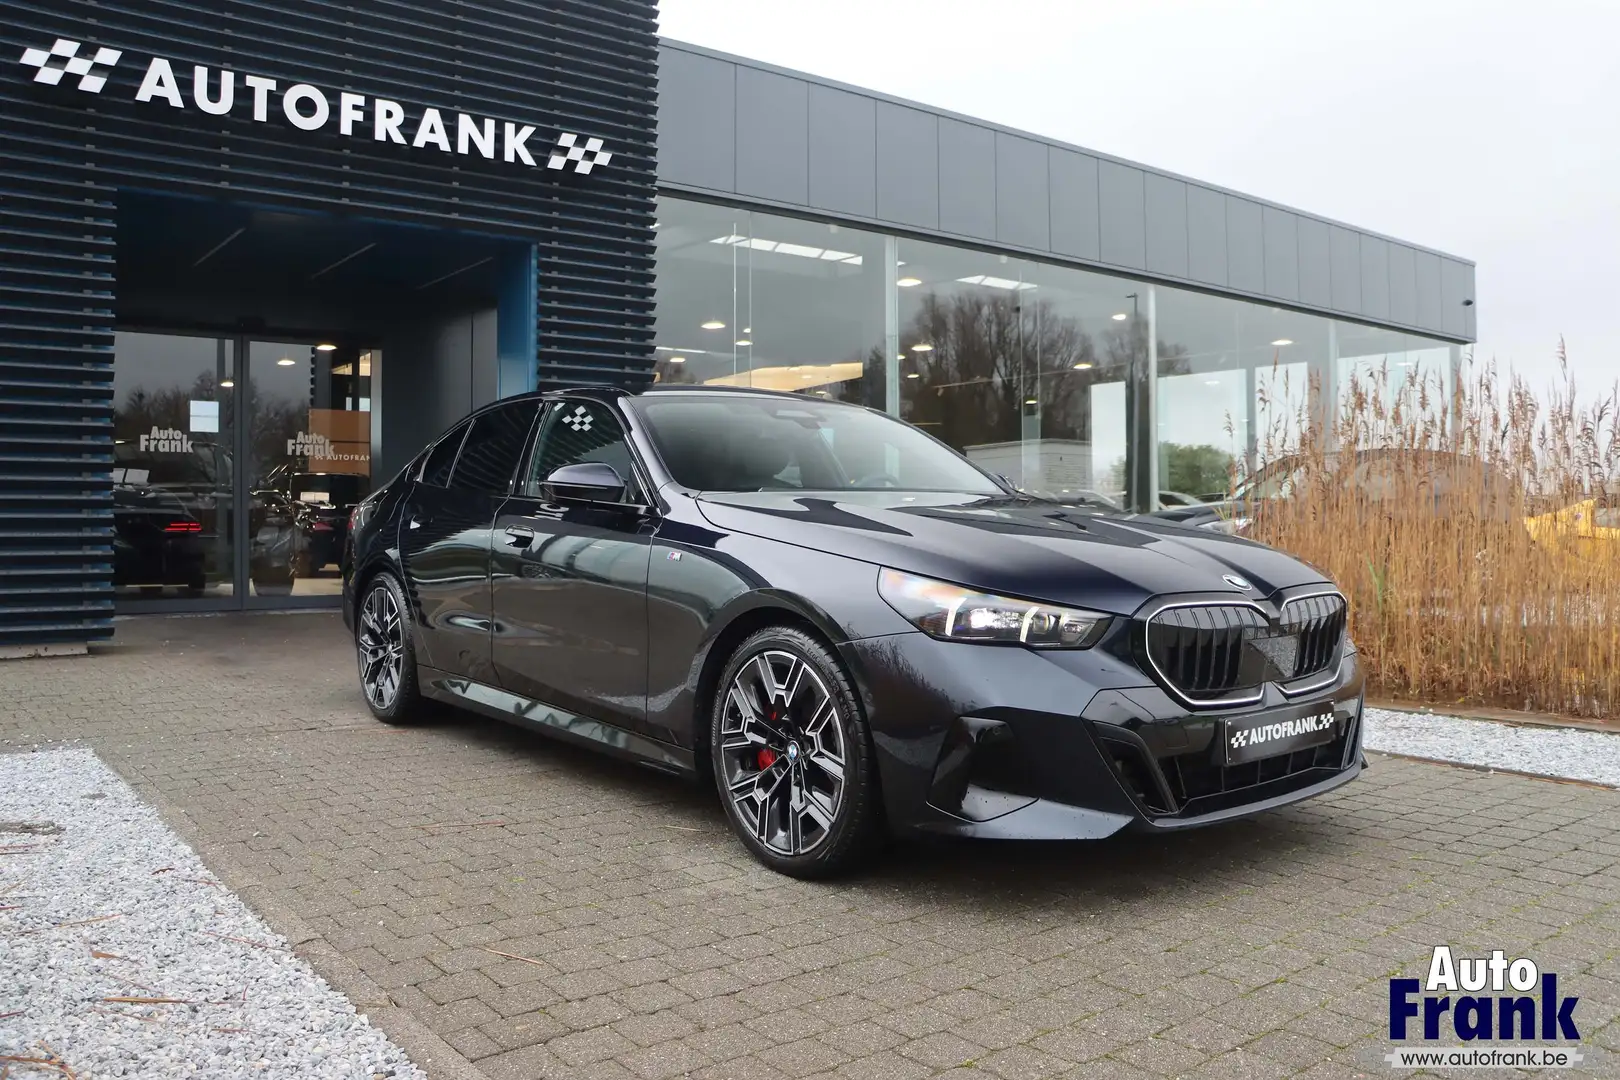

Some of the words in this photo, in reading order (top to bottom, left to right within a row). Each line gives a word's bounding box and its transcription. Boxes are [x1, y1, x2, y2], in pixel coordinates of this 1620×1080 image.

[135, 58, 537, 166] AUTOFRANK
[150, 426, 182, 440] Auto
[297, 431, 325, 444] Auto
[140, 435, 193, 453] Frank
[287, 439, 334, 456] Frank
[1249, 716, 1318, 745] AUTOFRANK
